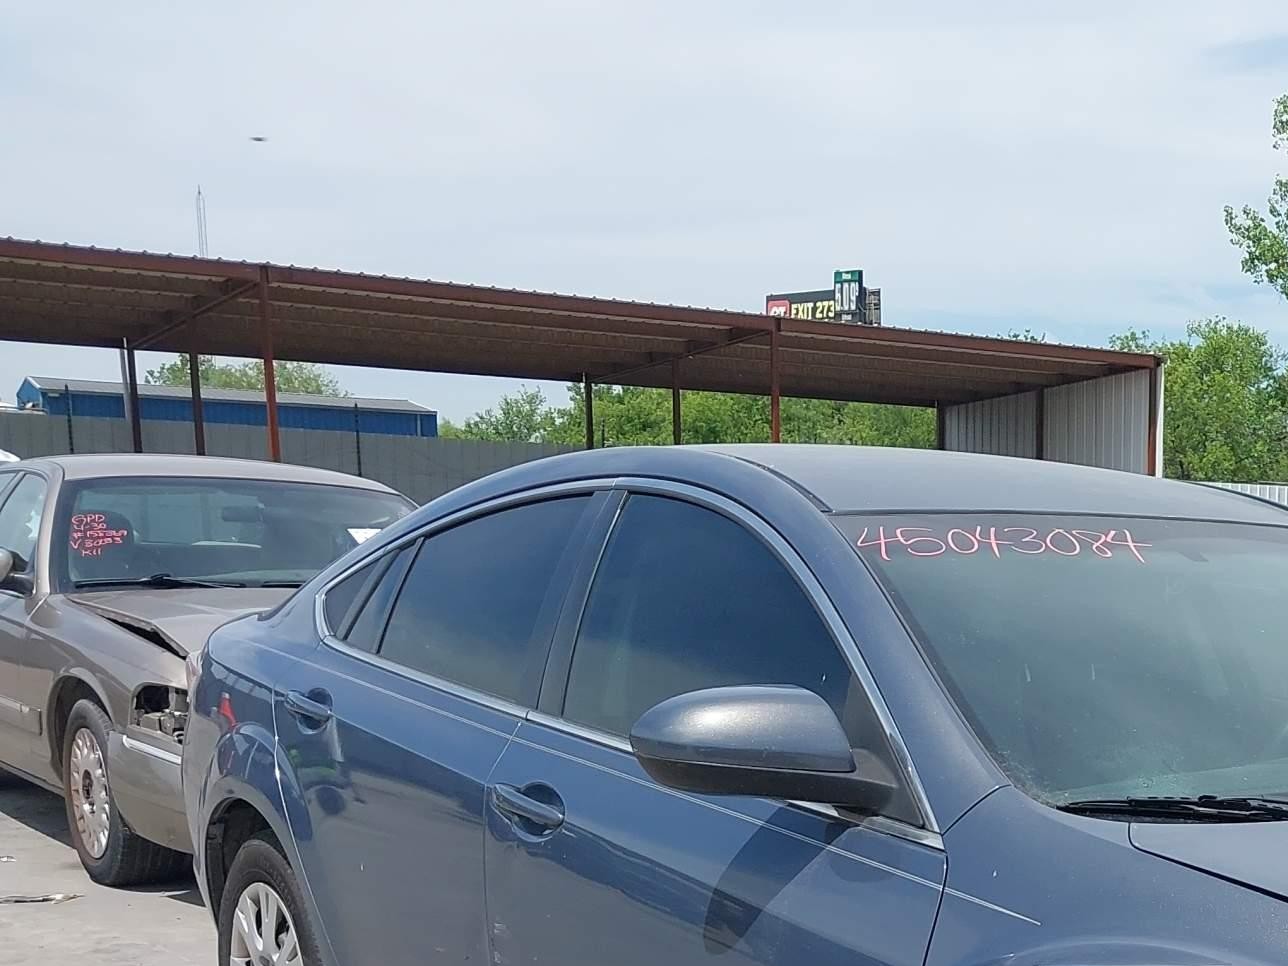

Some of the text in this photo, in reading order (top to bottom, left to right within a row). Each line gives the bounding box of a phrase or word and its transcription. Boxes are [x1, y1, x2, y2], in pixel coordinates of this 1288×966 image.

[791, 301, 814, 319] EXIT
[815, 300, 834, 318] 273
[857, 525, 1152, 563] 45043084
